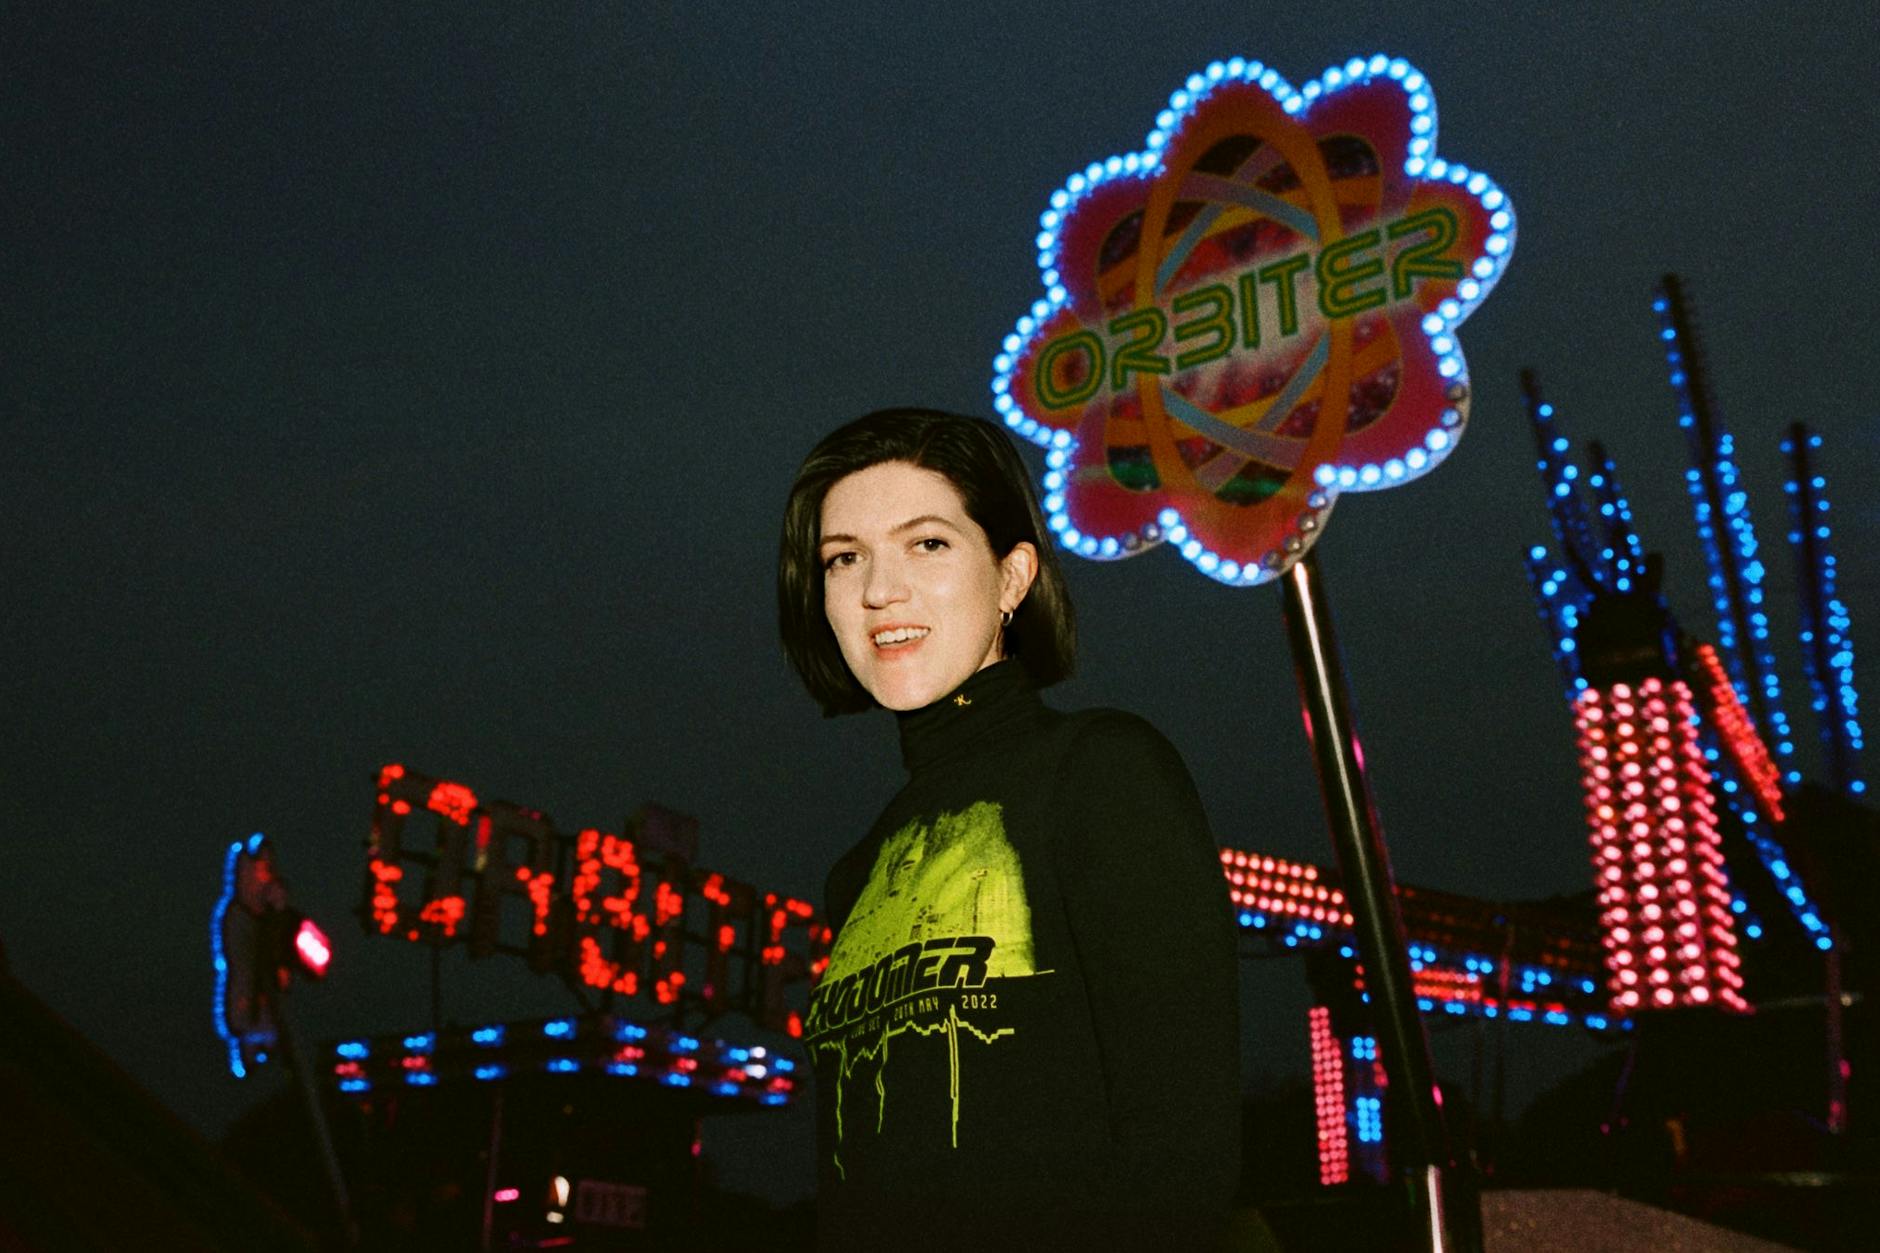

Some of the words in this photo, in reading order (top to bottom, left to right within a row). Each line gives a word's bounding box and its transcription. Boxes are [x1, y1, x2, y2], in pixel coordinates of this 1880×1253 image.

[1035, 206, 1464, 410] ORBITER
[918, 996, 940, 1014] MAY
[961, 994, 998, 1009] 2022
